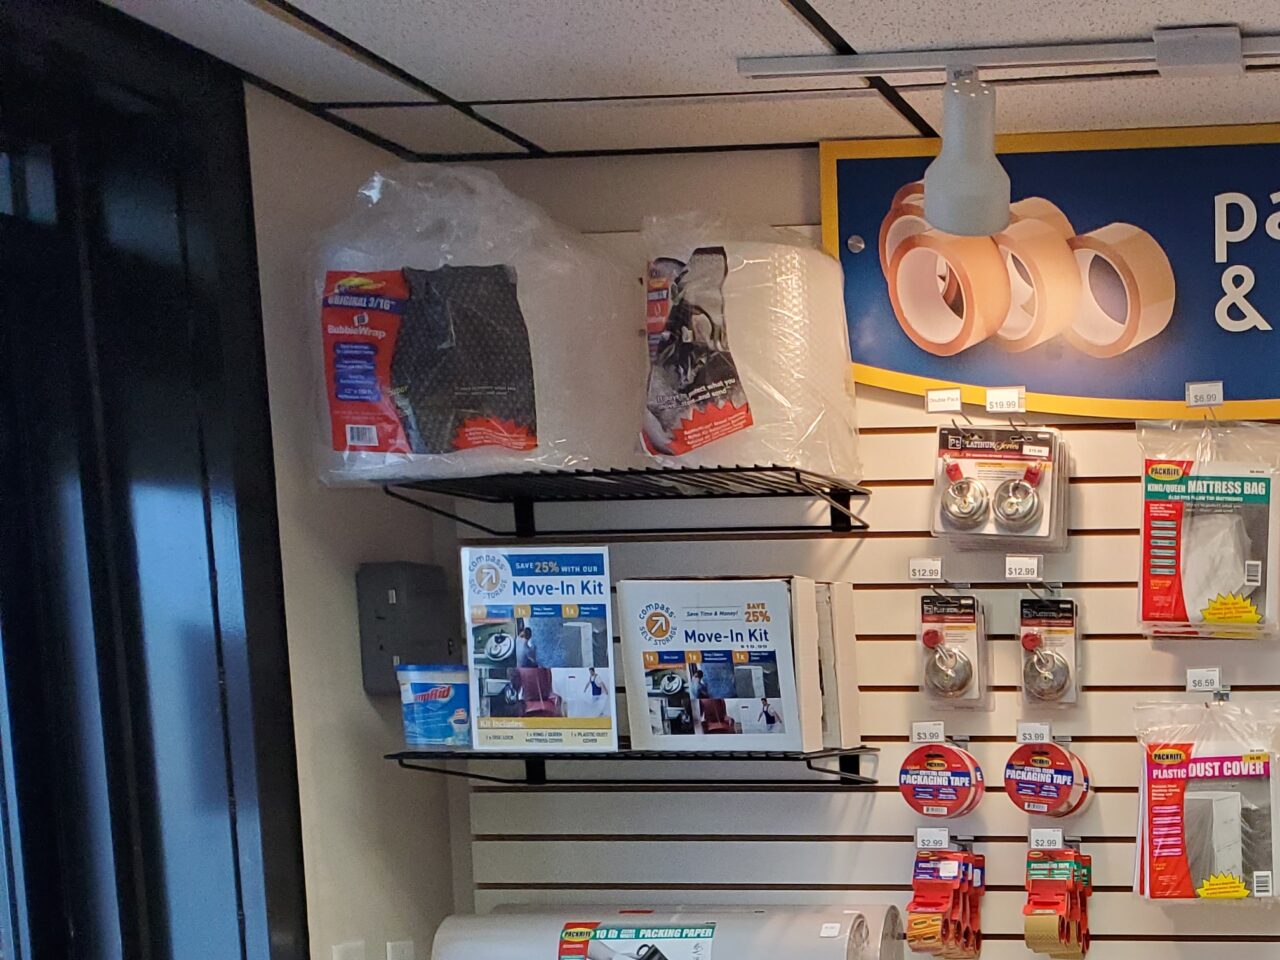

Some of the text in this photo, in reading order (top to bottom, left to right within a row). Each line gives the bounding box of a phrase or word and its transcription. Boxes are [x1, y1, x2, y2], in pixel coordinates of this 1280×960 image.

[1213, 265, 1273, 332] &
[327, 324, 386, 339] BubbleWrap
[1193, 393, 1217, 403] $6.99
[989, 401, 1016, 410] $19.99
[1151, 467, 1181, 476] PACKRITE
[1148, 480, 1265, 495] KING/QUEEN MATTRESS BAG
[534, 562, 560, 573] 25%
[912, 569, 939, 577] $12.99
[1008, 567, 1035, 576] $12.99
[513, 580, 604, 595] Move-In Kit
[639, 602, 675, 620] compass
[747, 602, 765, 610] SAVE
[745, 611, 771, 623] 25%
[685, 629, 769, 643] Move-In Kit
[917, 732, 939, 740] $3.99
[1022, 732, 1045, 741] $3.99
[1154, 752, 1183, 761] PACKRITE
[1152, 761, 1265, 779] PLASTIC DUST COVER
[900, 774, 970, 786] PACKAGING TAPE
[1006, 769, 1072, 785] PACKAGING TAPE
[921, 838, 943, 847] $2.99
[1035, 838, 1057, 847] $2.99
[564, 930, 592, 939] PACKRITE
[596, 930, 607, 939] 10
[639, 929, 682, 938] PACKING
[683, 928, 713, 938] PAPER
